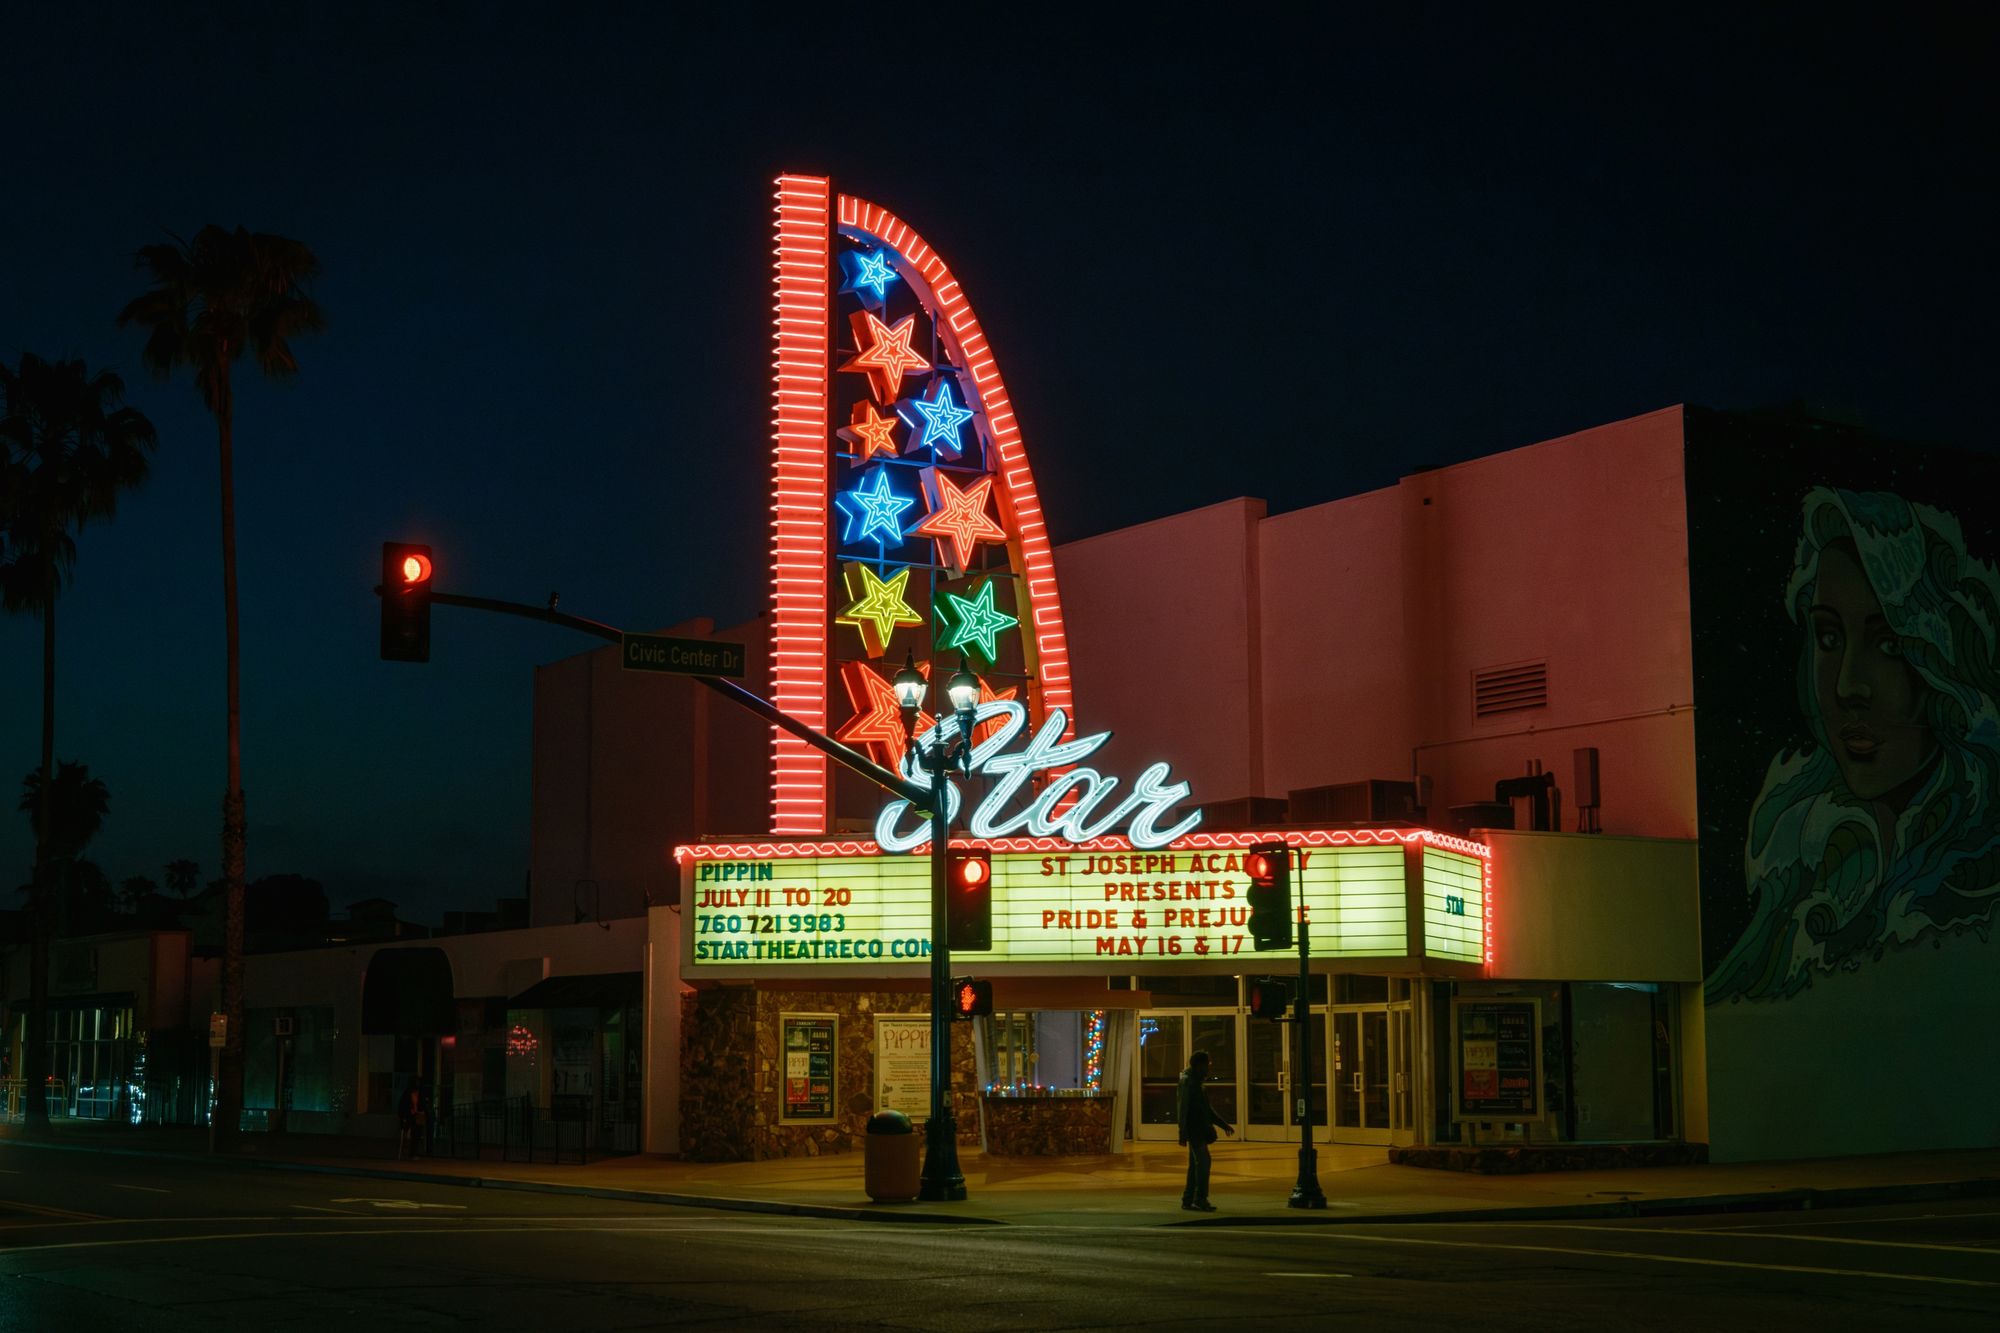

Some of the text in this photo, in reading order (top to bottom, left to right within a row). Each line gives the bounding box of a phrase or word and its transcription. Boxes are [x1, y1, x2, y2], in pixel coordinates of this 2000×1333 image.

[629, 641, 739, 669] Civic Center Dr
[875, 700, 1202, 851] Star
[701, 862, 773, 882] PIPPIN
[1040, 851, 1313, 876] ST JOSEPH ACAY
[697, 888, 749, 908] JULY
[782, 888, 811, 907] TO
[823, 887, 852, 907] 20
[1104, 879, 1236, 902] PRESENTS
[1042, 905, 1311, 929] PRIDE & PREJUE
[1446, 894, 1465, 917] STAR
[698, 913, 846, 934] 760 721 9983
[1096, 934, 1244, 956] MAY 16 & 17
